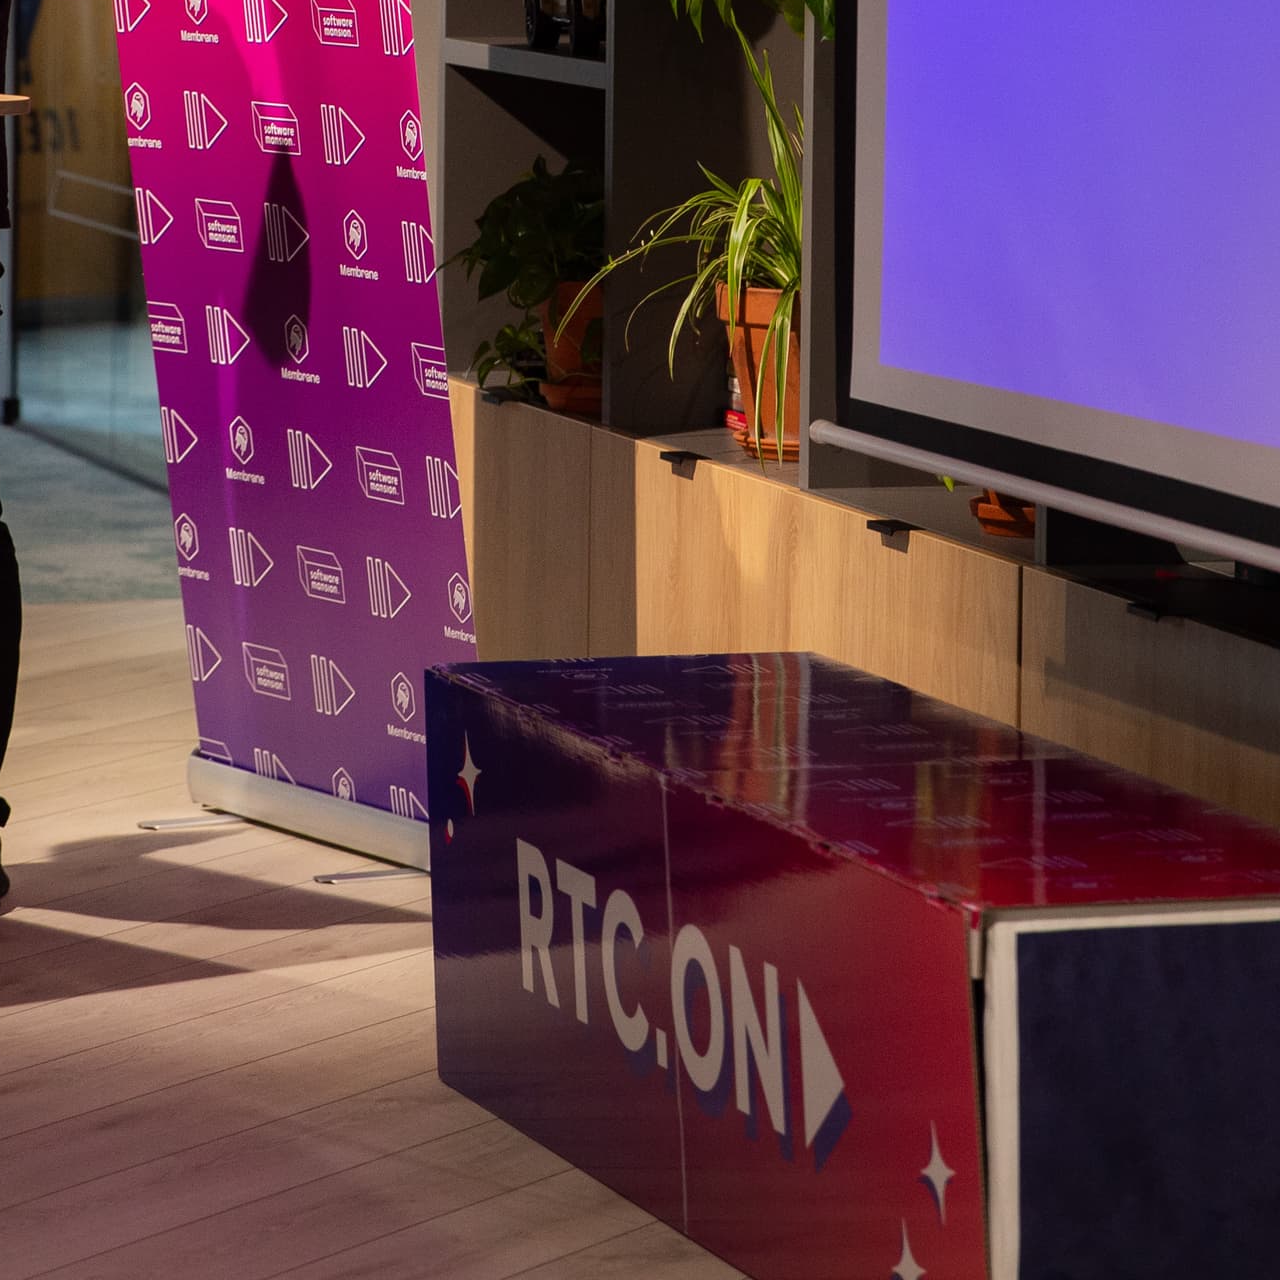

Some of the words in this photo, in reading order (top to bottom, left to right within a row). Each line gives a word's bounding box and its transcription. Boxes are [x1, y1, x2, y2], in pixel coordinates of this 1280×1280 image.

[323, 14, 353, 28] software
[180, 29, 219, 44] Membrane
[264, 122, 295, 137] software
[396, 166, 427, 181] Membra
[208, 220, 238, 234] software
[339, 263, 380, 281] Membrane
[151, 320, 182, 336] software
[281, 367, 321, 385] Membrane
[225, 467, 265, 485] Membrane
[369, 469, 399, 486] software
[310, 569, 340, 585] software
[444, 625, 477, 644] Membra
[256, 665, 285, 682] software
[387, 723, 427, 745] Membrane
[516, 837, 787, 1138] RTC.ON
